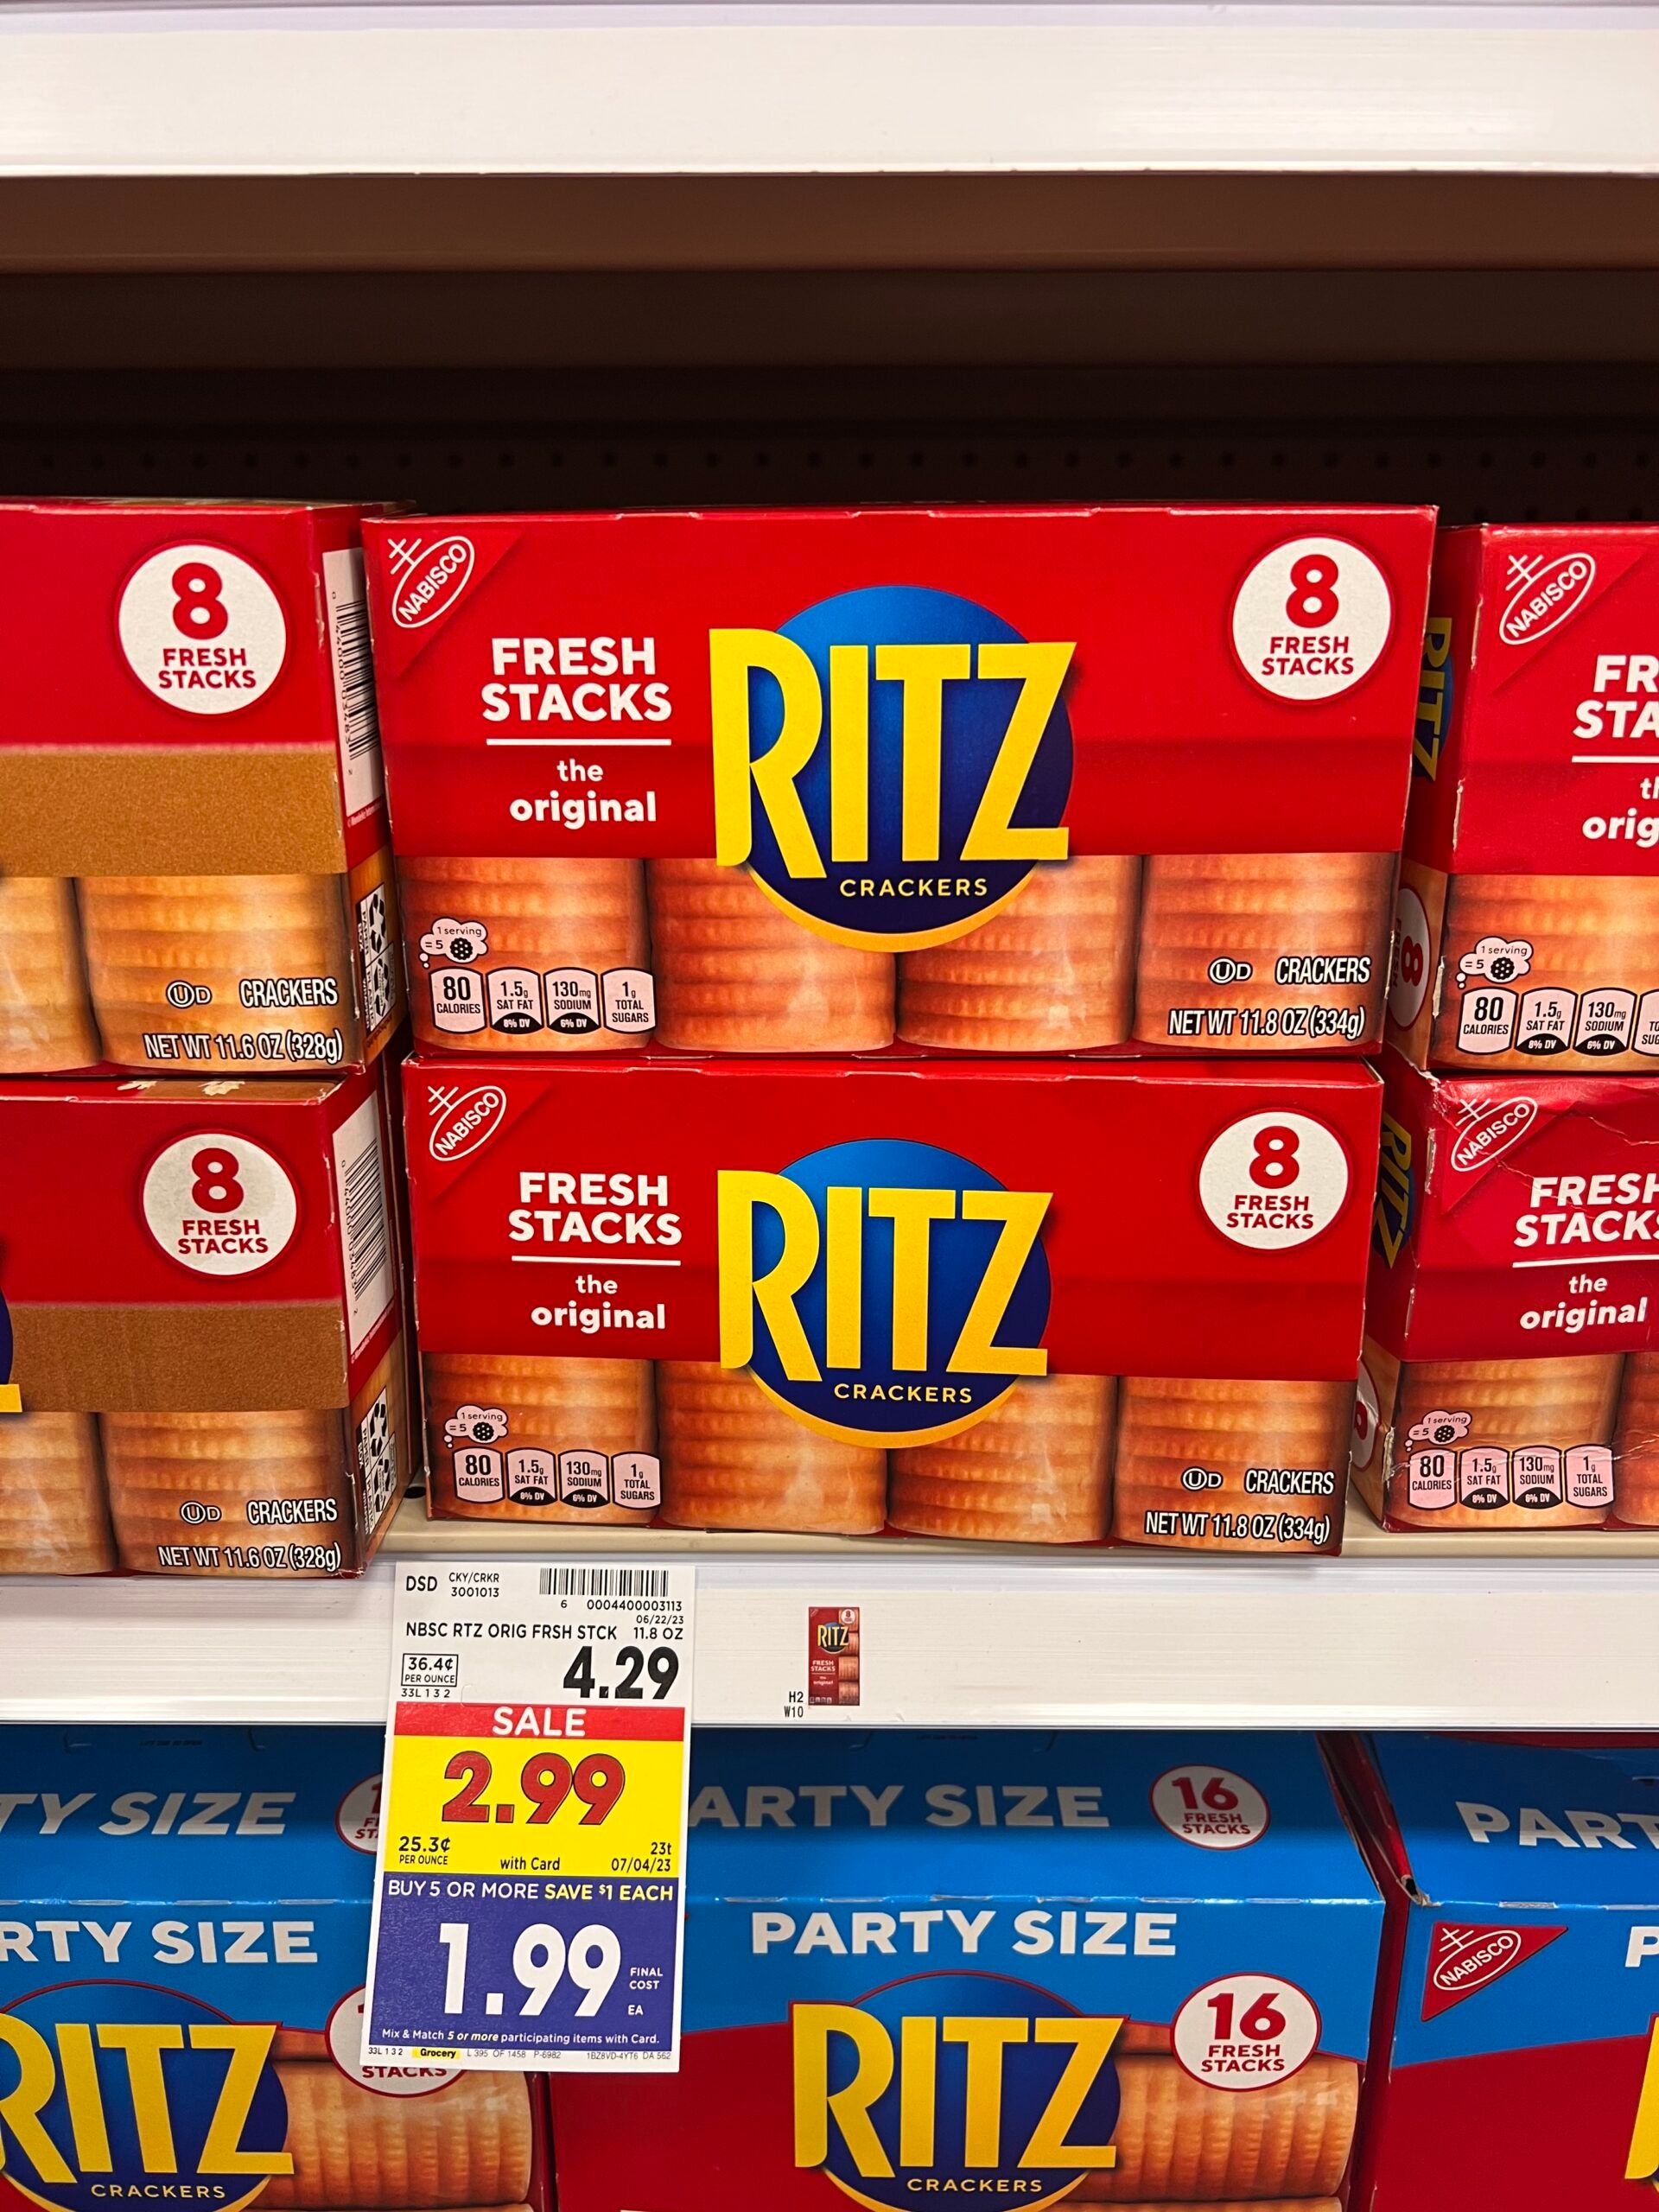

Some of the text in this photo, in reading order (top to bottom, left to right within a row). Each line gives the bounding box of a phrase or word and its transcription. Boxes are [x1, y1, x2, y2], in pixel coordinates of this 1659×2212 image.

[398, 543, 467, 621] NABISCO
[1286, 554, 1339, 629] 8
[172, 563, 229, 639] 8
[1507, 560, 1588, 638] NABISCO
[1269, 636, 1349, 655] FRESH
[162, 647, 247, 667] FRESH
[492, 637, 657, 676] FRESH
[1261, 658, 1355, 677] STACKS
[158, 669, 257, 690] STACKS
[481, 683, 672, 721] STACKS
[709, 628, 1077, 880] RITZ
[556, 759, 604, 783] the
[509, 790, 657, 830] original
[839, 877, 988, 898] CRACKERS
[436, 926, 482, 938] 1 serving
[435, 940, 444, 949] 5
[1274, 956, 1372, 985] CRACKERS
[240, 977, 339, 1007] CRACKERS
[442, 976, 471, 1001] 80
[500, 981, 529, 998] 1.5g
[552, 981, 591, 999] 130mg
[436, 1002, 481, 1014] CALORIES
[497, 1000, 533, 1010] SAT FAT
[554, 1000, 592, 1010] SODIUM
[615, 1000, 644, 1010] TOTAL
[612, 1013, 649, 1023] SUGARS
[1169, 1007, 1366, 1039] NET WT 11.8 OZ (334g)
[143, 1031, 344, 1064] NET WT 11.6 OZ (328g)
[435, 1091, 499, 1156] NABISCO
[1457, 1103, 1530, 1168] NABISCO
[1249, 1126, 1300, 1189] 8
[192, 1147, 245, 1213] 8
[519, 1172, 668, 1207] FRESH
[1234, 1194, 1309, 1212] FRESH
[181, 1219, 260, 1236] FRESH
[508, 1211, 682, 1246] STACKS
[1226, 1211, 1313, 1230] STACKS
[1513, 1210, 1659, 1248] STACK
[178, 1236, 269, 1255] STACKS
[575, 1274, 619, 1295] the
[717, 1170, 1053, 1382] RITZ
[1568, 1274, 1608, 1294] the
[531, 1300, 666, 1334] original
[1520, 1296, 1648, 1334] original
[834, 1382, 973, 1404] CRACKERS
[1245, 1469, 1335, 1497] CRACKERS
[247, 1498, 338, 1525] CRACKERS
[1145, 1511, 1331, 1544] NET WT 11.8 OZ (334g)
[406, 1575, 438, 1592] DSD
[448, 1572, 499, 1584] CKY/CRKR
[451, 1586, 499, 1598] 3001013
[561, 1599, 683, 1611] 6 0004400003113
[636, 1615, 684, 1624] 06/22/23
[406, 1622, 683, 1640] NBSC RTZ ORIG FRSH STCK 11.8 OZ
[817, 1624, 849, 1647] RITZ
[408, 1656, 454, 1671] 36.4¢
[563, 1645, 679, 1700] 4.29
[405, 1674, 455, 1684] PER OUNCE
[401, 1688, 422, 1698] 33L
[789, 1691, 804, 1703] H2
[493, 1707, 586, 1738] SALE
[784, 1706, 804, 1718] W10
[442, 1750, 626, 1826] 2.99
[1172, 1777, 1239, 1811] 16
[99, 1791, 296, 1835] SIZE
[925, 1785, 1110, 1827] SIZE
[1181, 1822, 1251, 1836] STACKS
[1184, 1812, 1243, 1825] FRESH
[1455, 1802, 1659, 1850] PART
[398, 1835, 451, 1853] 25.3¢
[651, 1841, 671, 1855] 23t
[399, 1854, 448, 1866] PER OUNCE
[500, 1857, 560, 1871] with Card
[611, 1858, 671, 1872] 07/04/23
[388, 1880, 426, 1897] BUY
[429, 1882, 441, 1897] 5
[447, 1881, 474, 1898] OR
[481, 1883, 539, 1899] MORE
[544, 1884, 593, 1900] SAVE
[619, 1885, 674, 1901] EACH
[0, 1921, 318, 1964] RTY SIZE
[752, 1910, 1178, 1955] PARTY SIZE
[439, 1923, 621, 2017] 1.99
[1440, 1936, 1514, 1986] NABISCO
[630, 1967, 664, 1977] FINAL
[629, 1980, 659, 1990] COST
[627, 2005, 644, 2016] EA
[1206, 1993, 1287, 2042] 16
[382, 2029, 660, 2046] Mix & Match 5 or more participating items with Card.
[420, 2049, 456, 2059] Grocery
[474, 2049, 488, 2057] 395
[493, 2049, 505, 2058] OF
[507, 2050, 526, 2058] 1458
[534, 2050, 561, 2059] P-6982
[643, 2051, 655, 2060] DA
[1208, 2044, 1281, 2059] FRESH
[1200, 2058, 1286, 2074] STACKS
[0, 2013, 295, 2183] RITZ
[793, 2004, 1124, 2178] RITZ
[91, 2183, 226, 2199] CRACKERS
[906, 2177, 1043, 2194] CRACKERS
